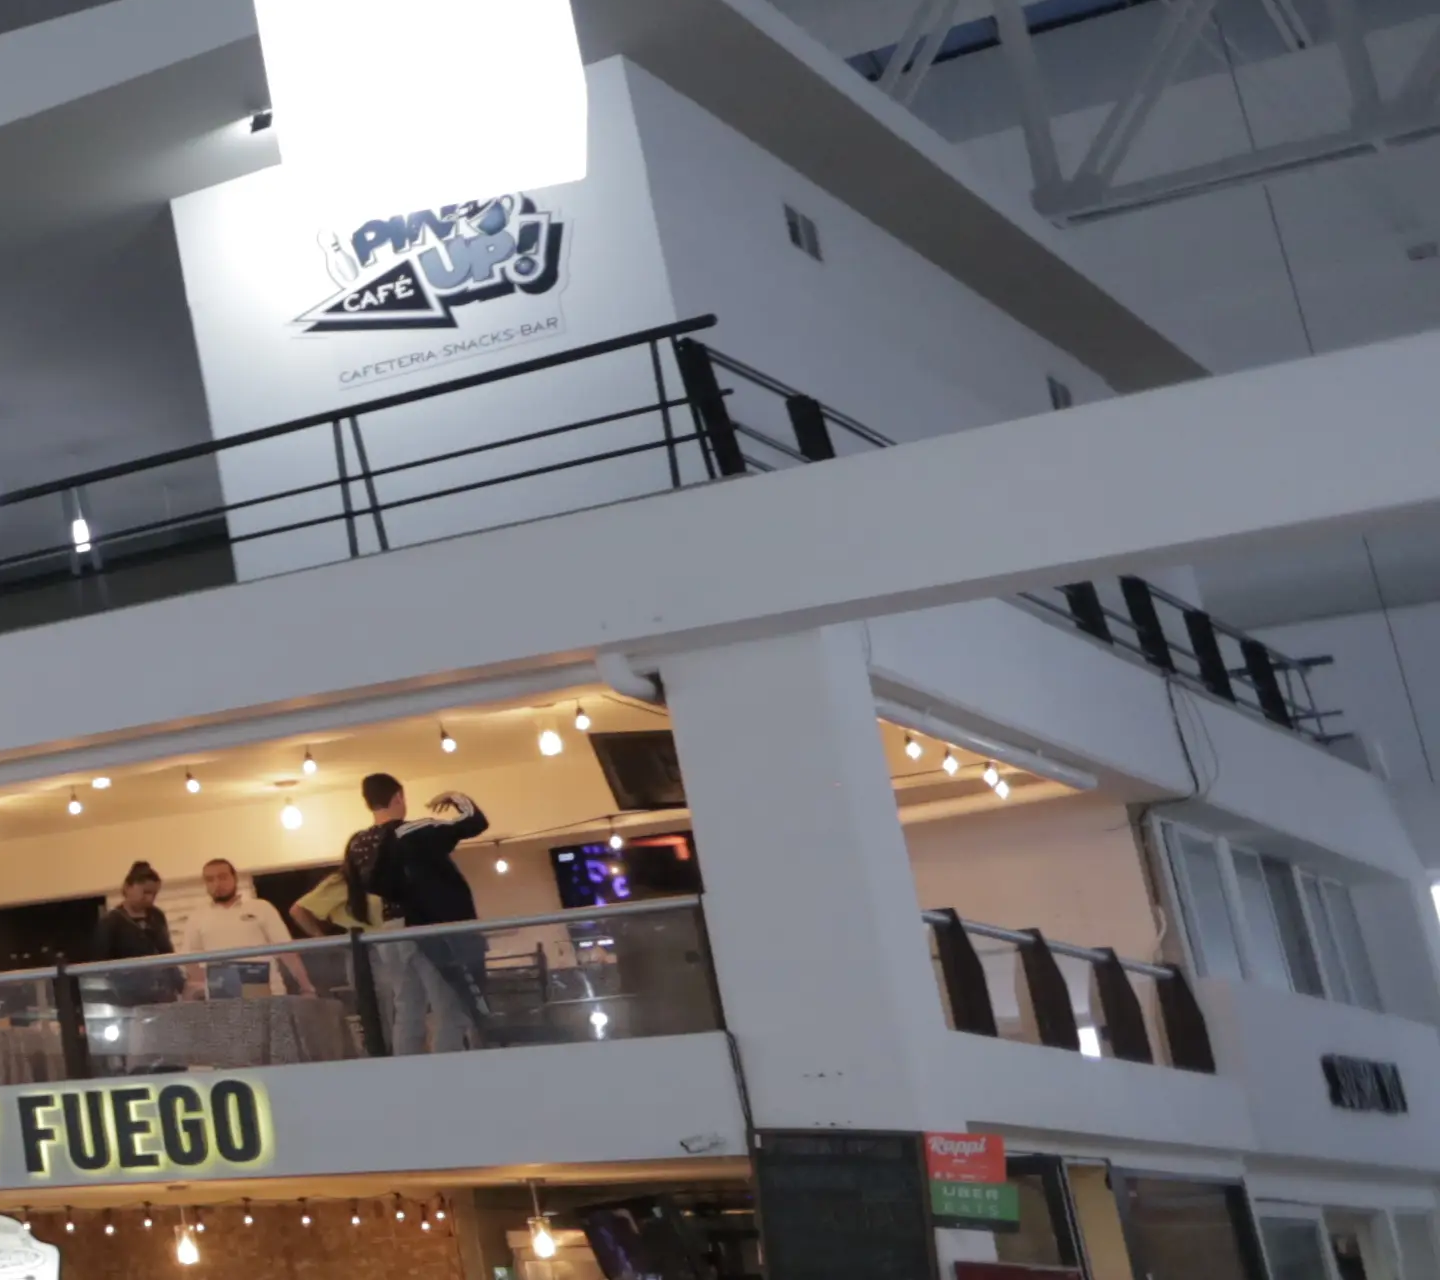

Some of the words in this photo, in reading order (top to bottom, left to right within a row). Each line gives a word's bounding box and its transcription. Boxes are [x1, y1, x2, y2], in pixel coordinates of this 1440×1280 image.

[342, 275, 416, 312] CAFÉ
[18, 1079, 264, 1174] FUEGO
[928, 1135, 987, 1157] Rappi
[942, 1185, 1000, 1200] UBER
